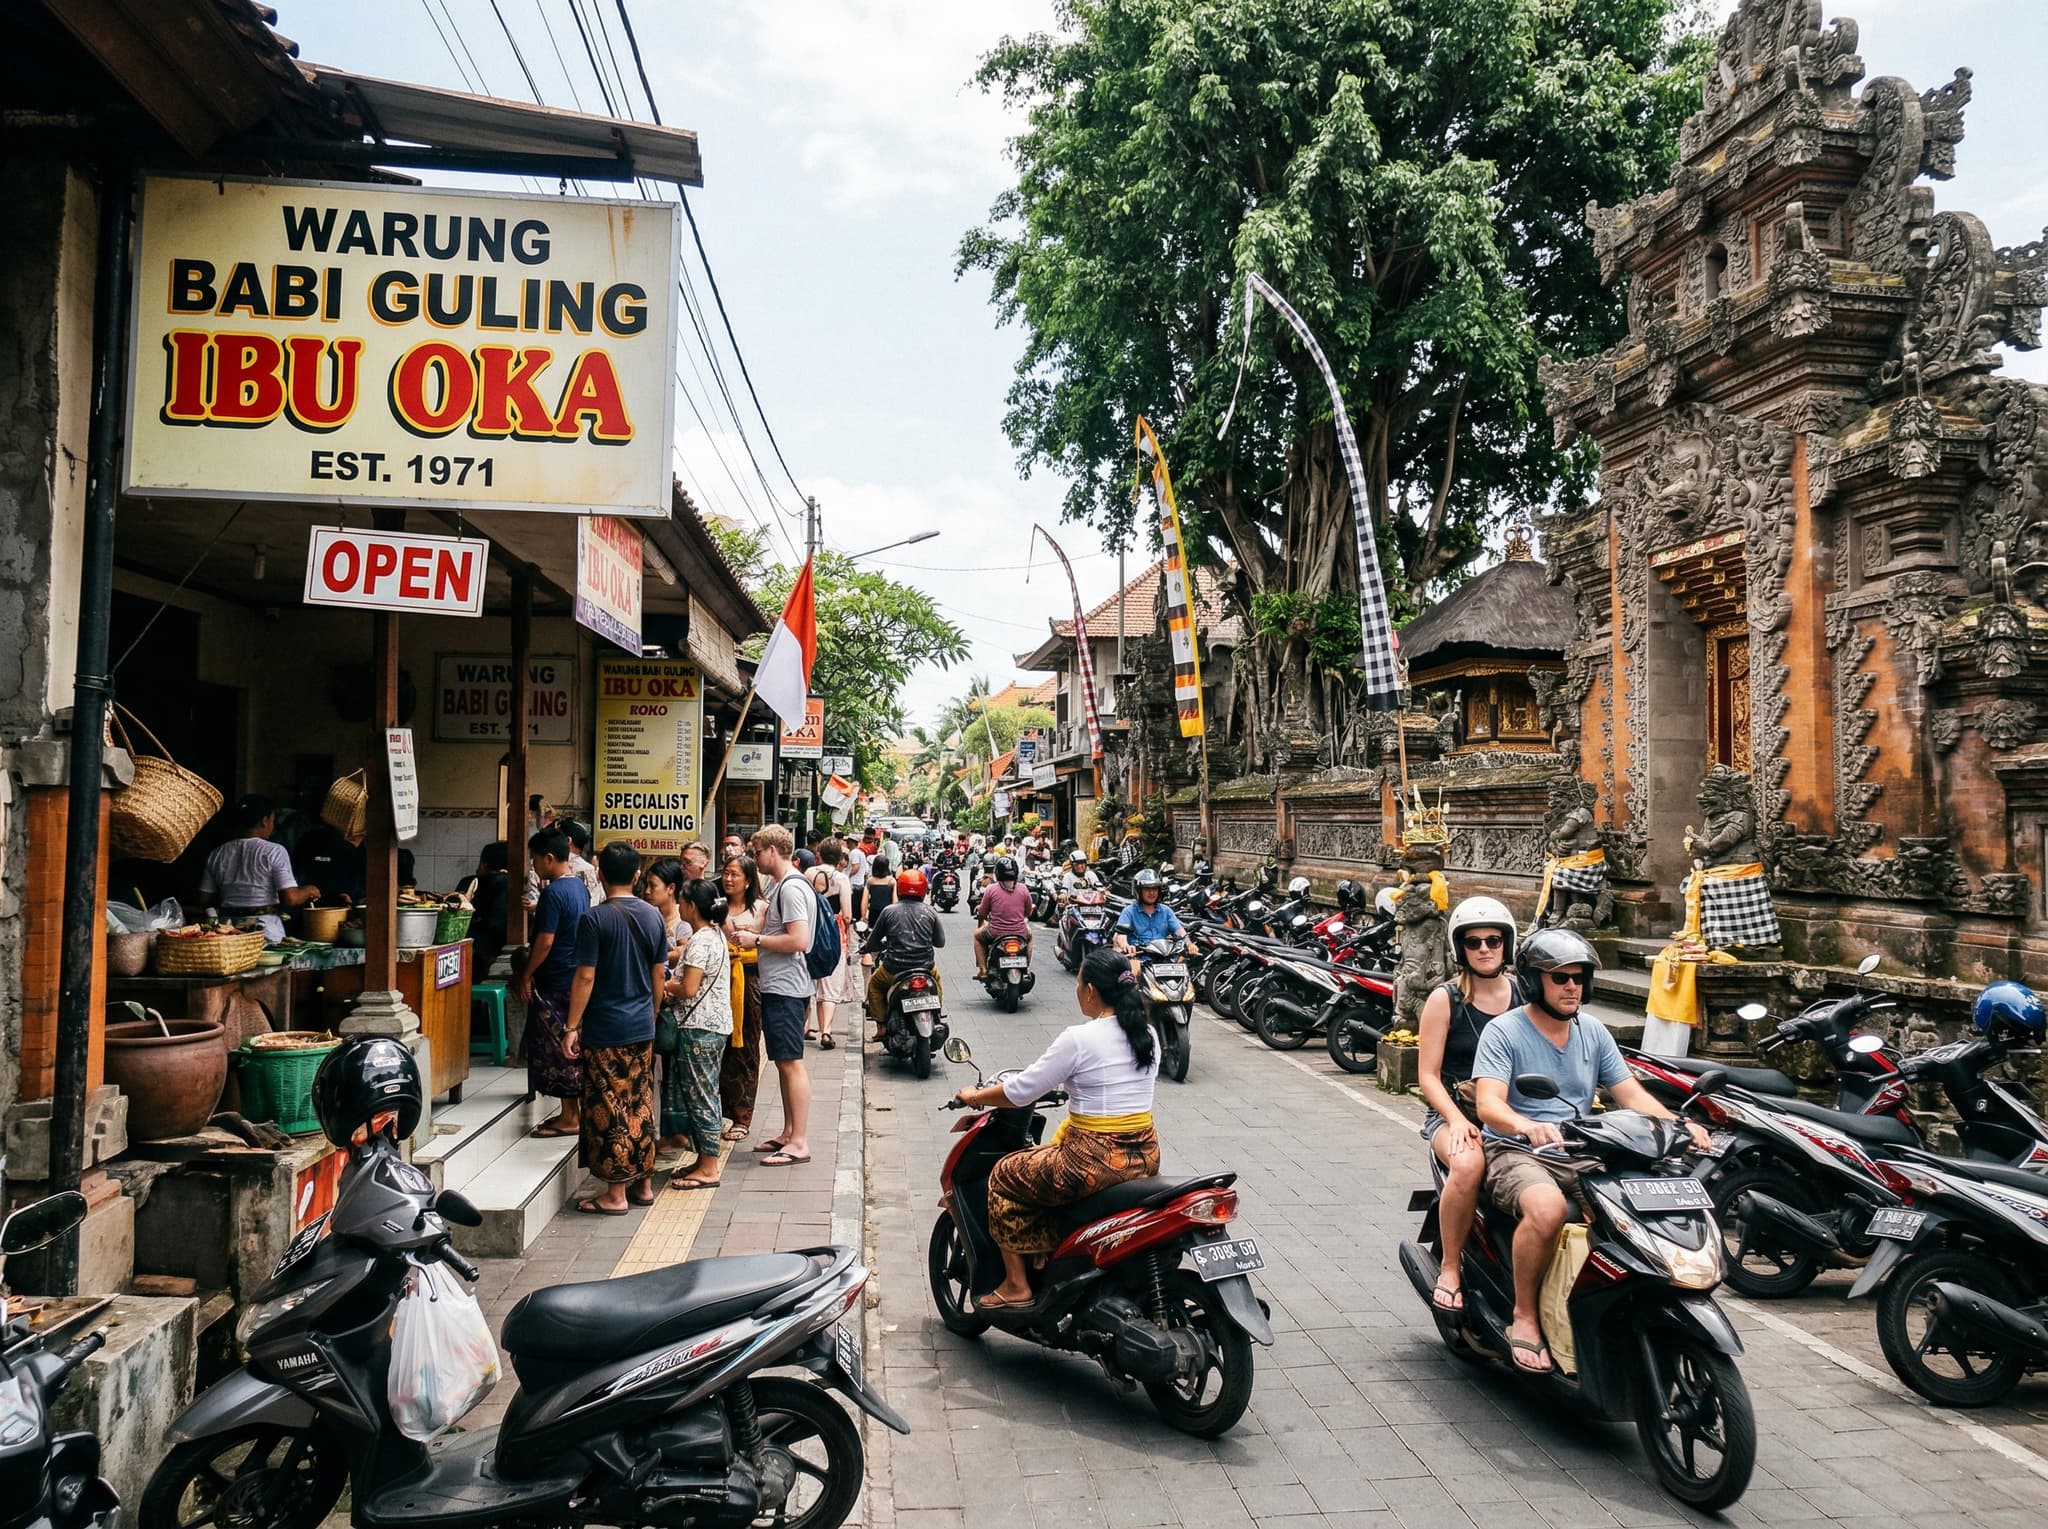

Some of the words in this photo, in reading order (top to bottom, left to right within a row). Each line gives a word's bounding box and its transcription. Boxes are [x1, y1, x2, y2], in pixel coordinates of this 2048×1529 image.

[282, 205, 551, 265] WARUNG
[168, 258, 343, 322] BABI
[367, 271, 648, 337] GULING
[159, 328, 366, 433] IBU
[388, 340, 635, 445] OKA
[310, 451, 391, 482] EST.
[406, 455, 494, 487] 1971
[322, 540, 474, 602] OPEN
[587, 543, 609, 598] IBU
[610, 562, 632, 616] OKA
[443, 688, 489, 715] BABI
[495, 689, 568, 717] GING
[603, 677, 643, 696] IBU
[647, 679, 696, 697] OKA
[469, 723, 501, 735] EST.
[604, 792, 689, 810] SPECIALIST
[599, 813, 634, 830] BABI
[638, 814, 694, 831] GULING
[277, 1352, 318, 1370] YAMAHA
